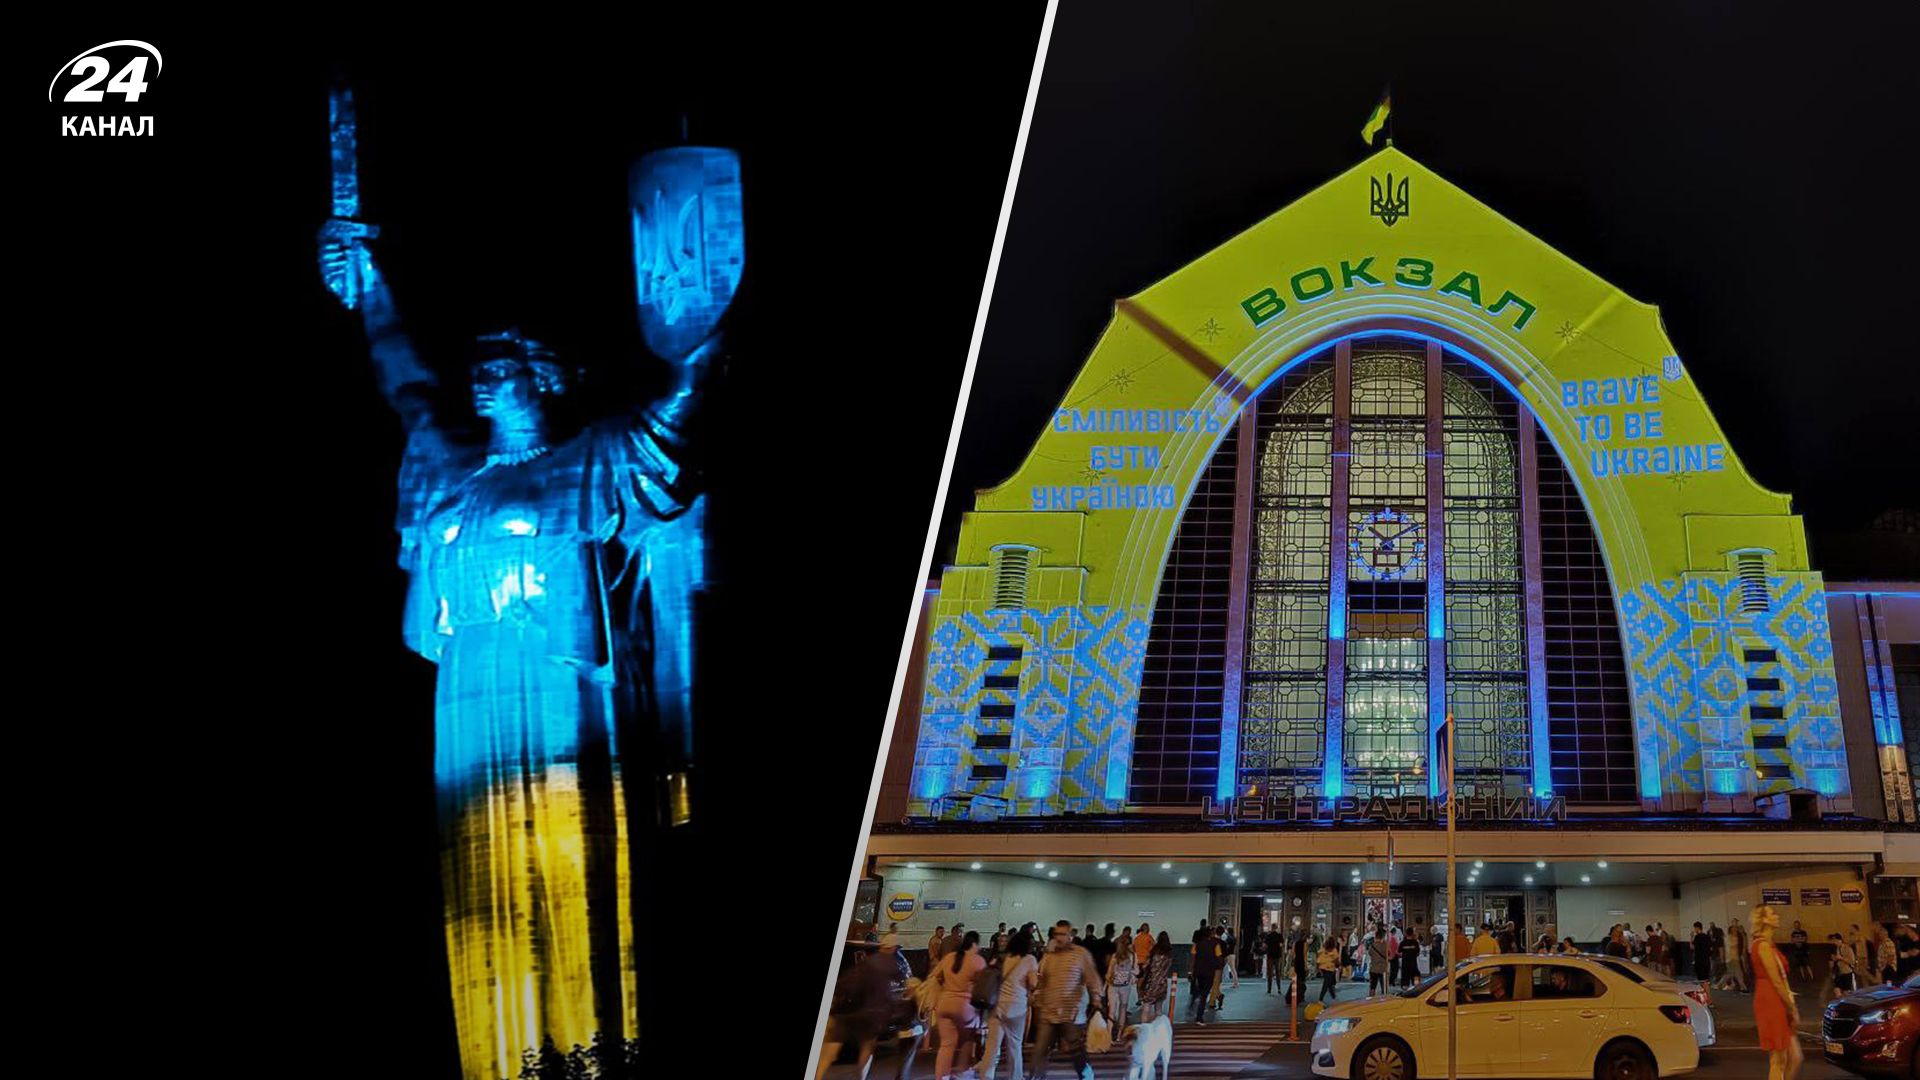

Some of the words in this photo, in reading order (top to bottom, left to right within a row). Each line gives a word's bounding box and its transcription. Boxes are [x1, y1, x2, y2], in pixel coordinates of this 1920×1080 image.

[1240, 256, 1537, 332] ВОКЗАЛ
[1053, 408, 1222, 433] СМІЛИВІСТЬ
[1575, 414, 1611, 443] TO
[1624, 411, 1663, 440] BE
[1090, 445, 1161, 471] БУТИ
[1201, 791, 1567, 825] ЦЕНТРАЛЬНИЙ
